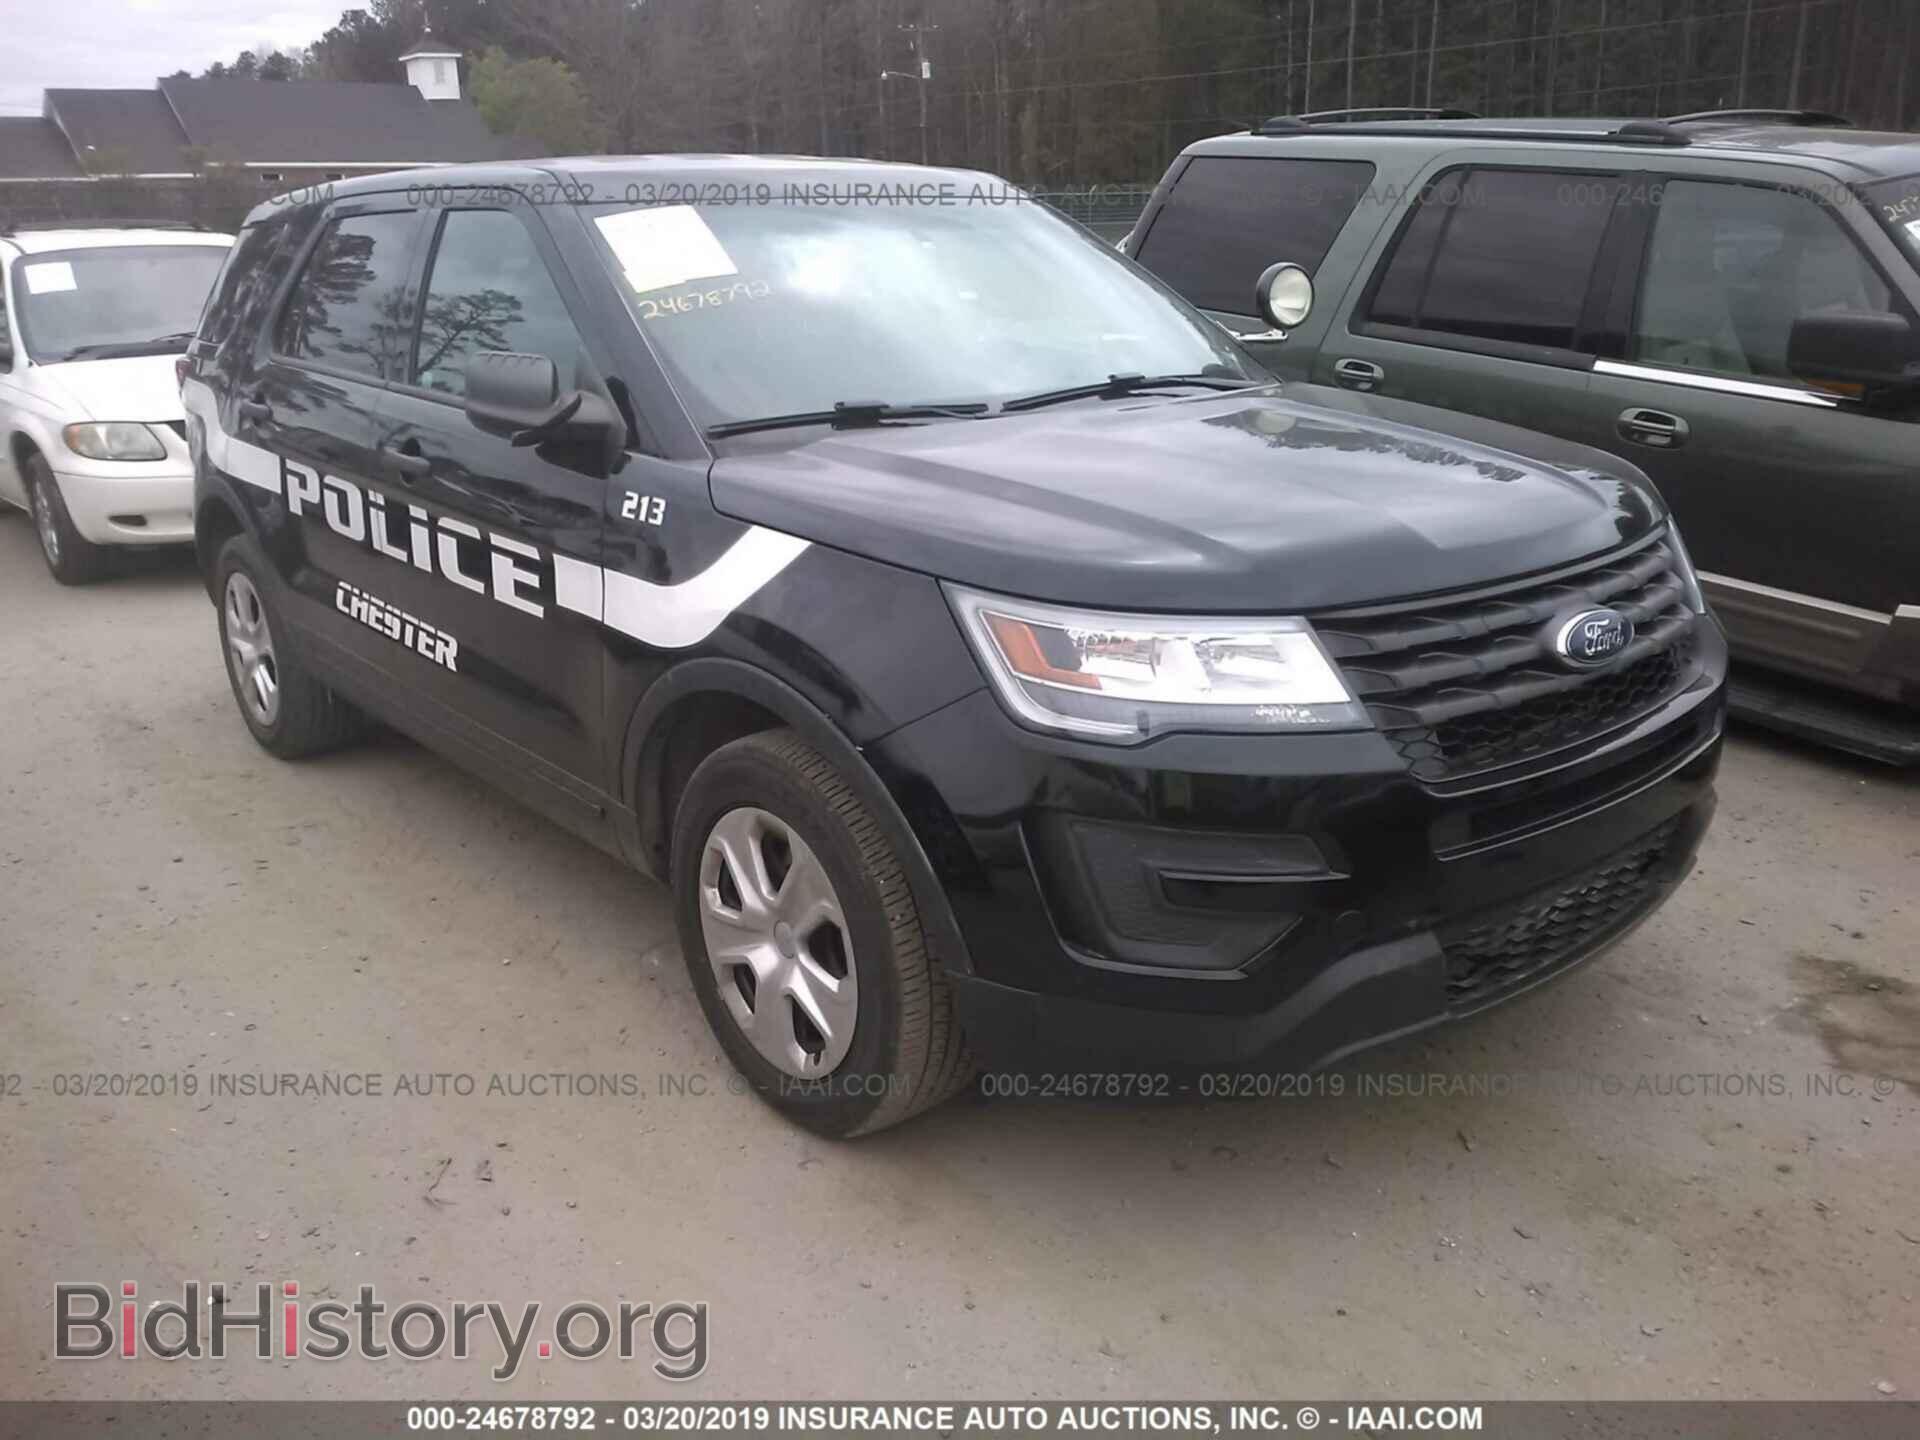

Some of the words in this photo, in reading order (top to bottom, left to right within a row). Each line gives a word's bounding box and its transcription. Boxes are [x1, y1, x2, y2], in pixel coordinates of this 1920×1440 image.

[286, 457, 545, 620] POLICE
[621, 490, 667, 526] 213
[335, 580, 460, 672] CHESTER
[1584, 618, 1625, 657] Ford
